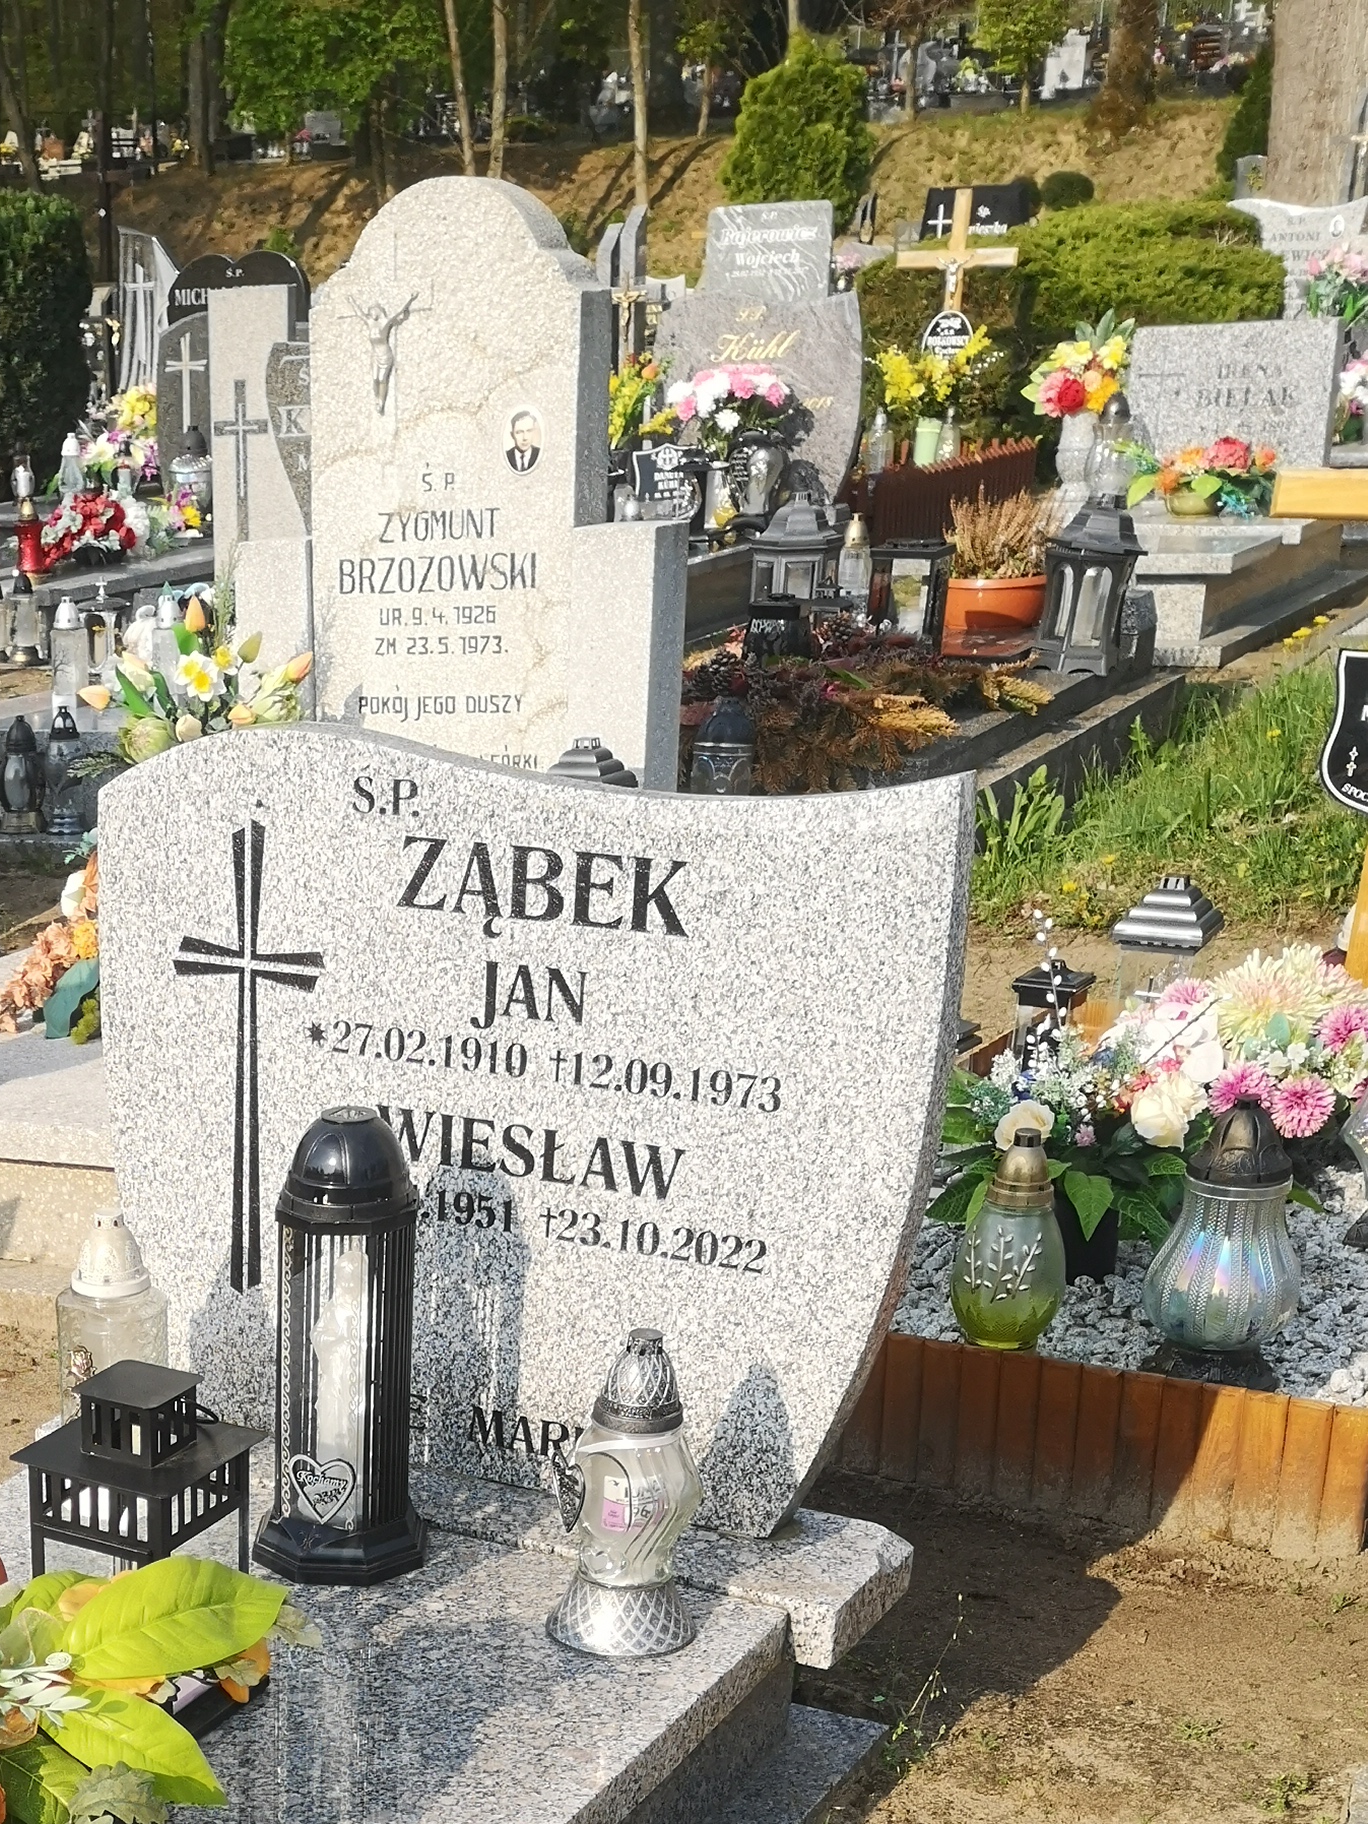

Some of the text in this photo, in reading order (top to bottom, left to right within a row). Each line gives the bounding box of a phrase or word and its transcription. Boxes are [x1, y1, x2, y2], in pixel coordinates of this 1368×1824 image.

[710, 330, 801, 362] Kühl
[378, 507, 500, 543] ZYGMUNT
[338, 552, 537, 595] BRZOZOWSKI
[374, 637, 396, 656] ZM
[358, 685, 523, 721] POKÓJ JEGO DUSZY
[353, 764, 420, 818] Ś.P.
[396, 835, 689, 939] ZĄBEK
[469, 960, 589, 1030] JAN
[376, 1104, 687, 1201] WIESŁAW
